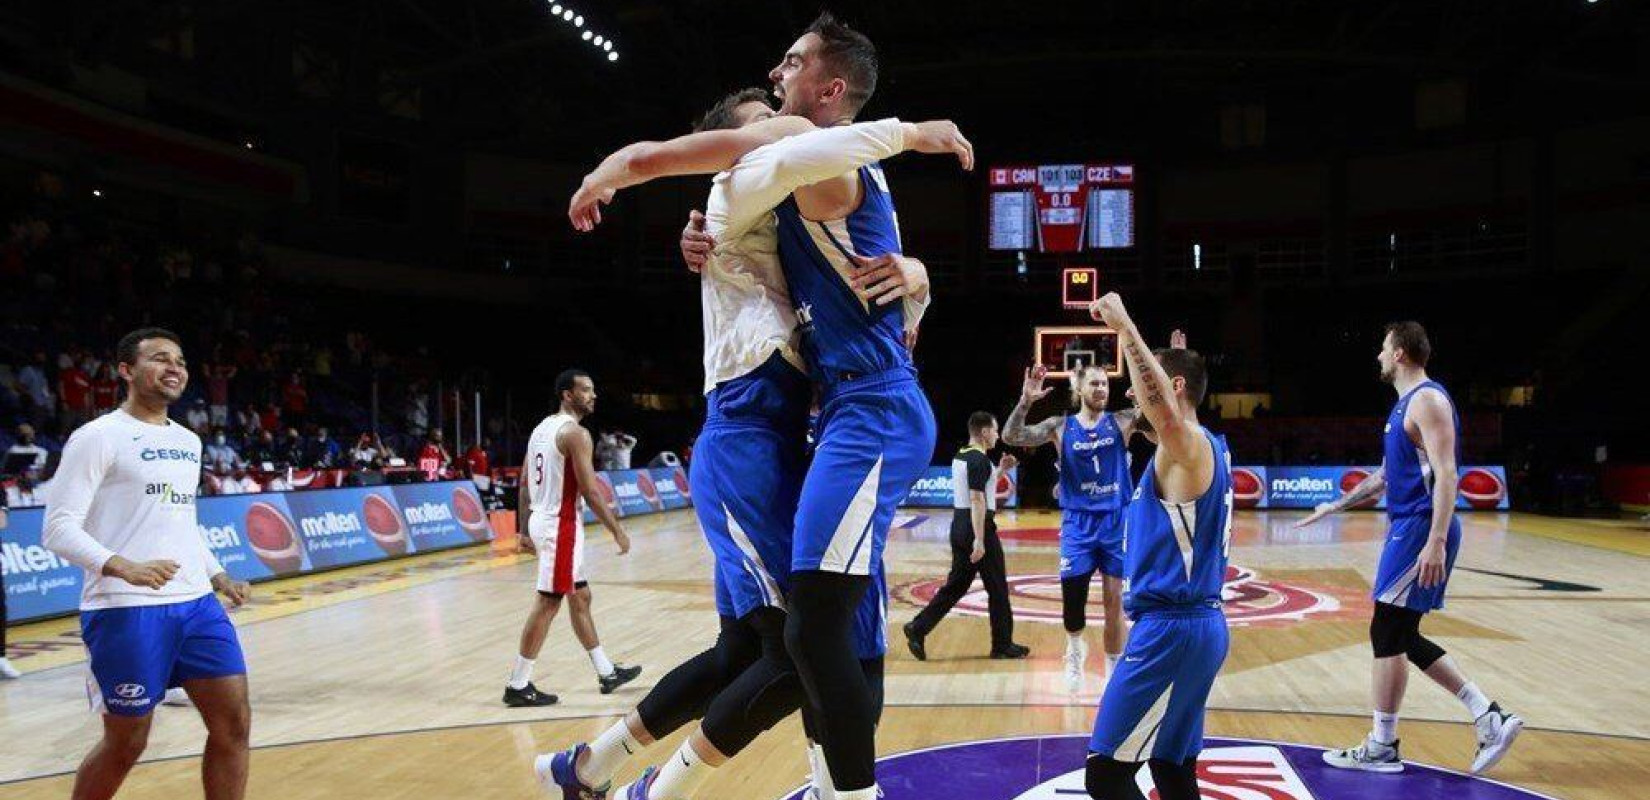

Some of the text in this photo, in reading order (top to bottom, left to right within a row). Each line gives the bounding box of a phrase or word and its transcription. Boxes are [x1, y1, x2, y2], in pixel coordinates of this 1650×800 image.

[1012, 169, 1036, 183] CAN
[1087, 167, 1111, 181] CZE
[1052, 194, 1071, 207] 0.0
[1092, 454, 1100, 474] 1
[146, 481, 167, 495] air
[1273, 477, 1333, 490] molten
[171, 490, 197, 504] ban
[405, 503, 452, 523] molten
[302, 512, 360, 537] molten
